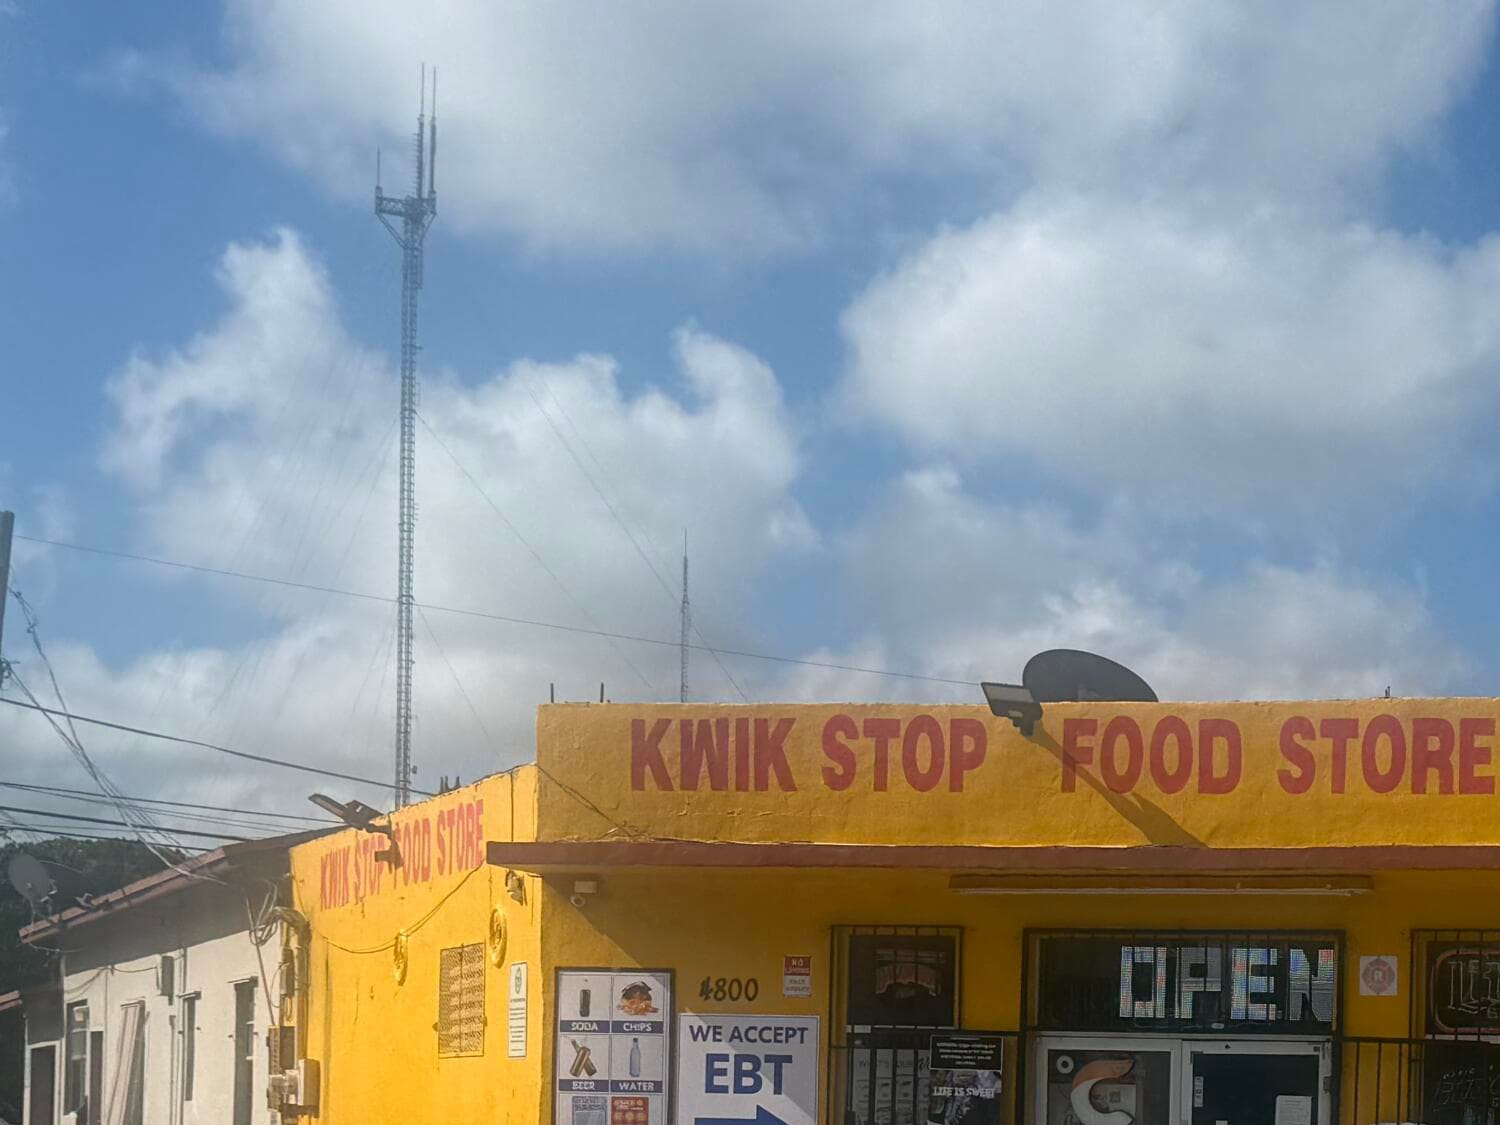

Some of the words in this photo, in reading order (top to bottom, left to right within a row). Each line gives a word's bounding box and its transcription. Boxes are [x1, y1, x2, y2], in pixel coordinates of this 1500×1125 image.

[630, 716, 797, 792] KWIK
[821, 714, 987, 794] STOP
[1062, 714, 1242, 796] FOOD
[1277, 714, 1496, 796] STORE
[320, 846, 351, 911] KWIK
[353, 835, 385, 906] STOP
[437, 799, 484, 876] STORE
[699, 976, 759, 1002] 4800
[1119, 945, 1335, 1022] OPEN
[571, 1022, 599, 1032] SODA
[623, 1023, 653, 1033] CHIPS
[689, 1025, 722, 1043] WE
[728, 1026, 809, 1044] ACCEPT
[705, 1053, 793, 1096] EBT
[571, 1081, 596, 1091] BEER
[618, 1082, 655, 1092] WATER
[934, 1086, 953, 1097] LIFE
[955, 1087, 965, 1097] IS
[966, 1088, 995, 1099] SWEET
